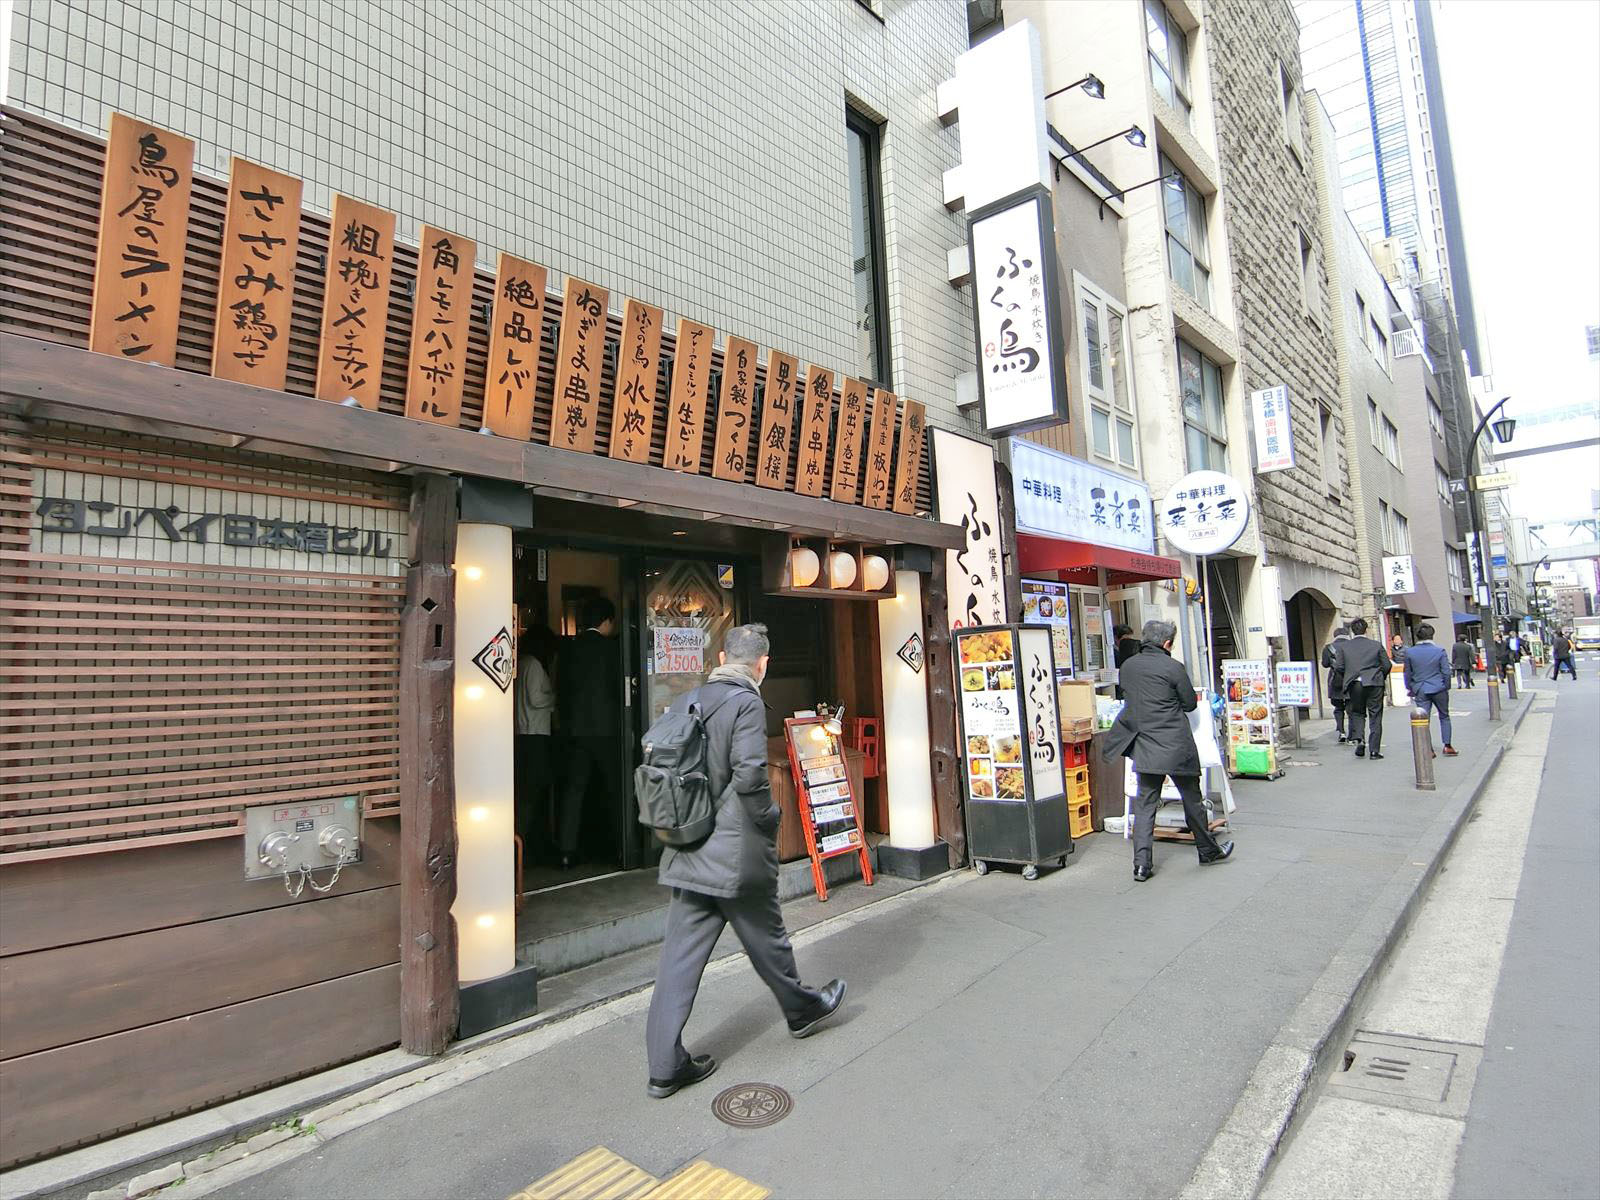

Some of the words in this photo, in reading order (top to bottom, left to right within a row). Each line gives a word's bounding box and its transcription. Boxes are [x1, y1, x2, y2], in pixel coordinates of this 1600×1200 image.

[115, 133, 180, 356] 鳥屋のラーメン
[229, 184, 287, 369] ささみ鶏わさ
[332, 218, 386, 391] 粗挽きメンチカツ
[990, 246, 1040, 373] ふくの鳥
[419, 236, 460, 418] 角レモンハイボール
[499, 275, 539, 418] 絶品レバー
[564, 288, 603, 446] ねぎま串焼き
[620, 373, 652, 458] 水炊き
[674, 401, 696, 468] 生ビール
[1022, 477, 1063, 504] 中華料理
[1176, 484, 1226, 501] 中華料理
[1030, 653, 1056, 763] ふくの鳥
